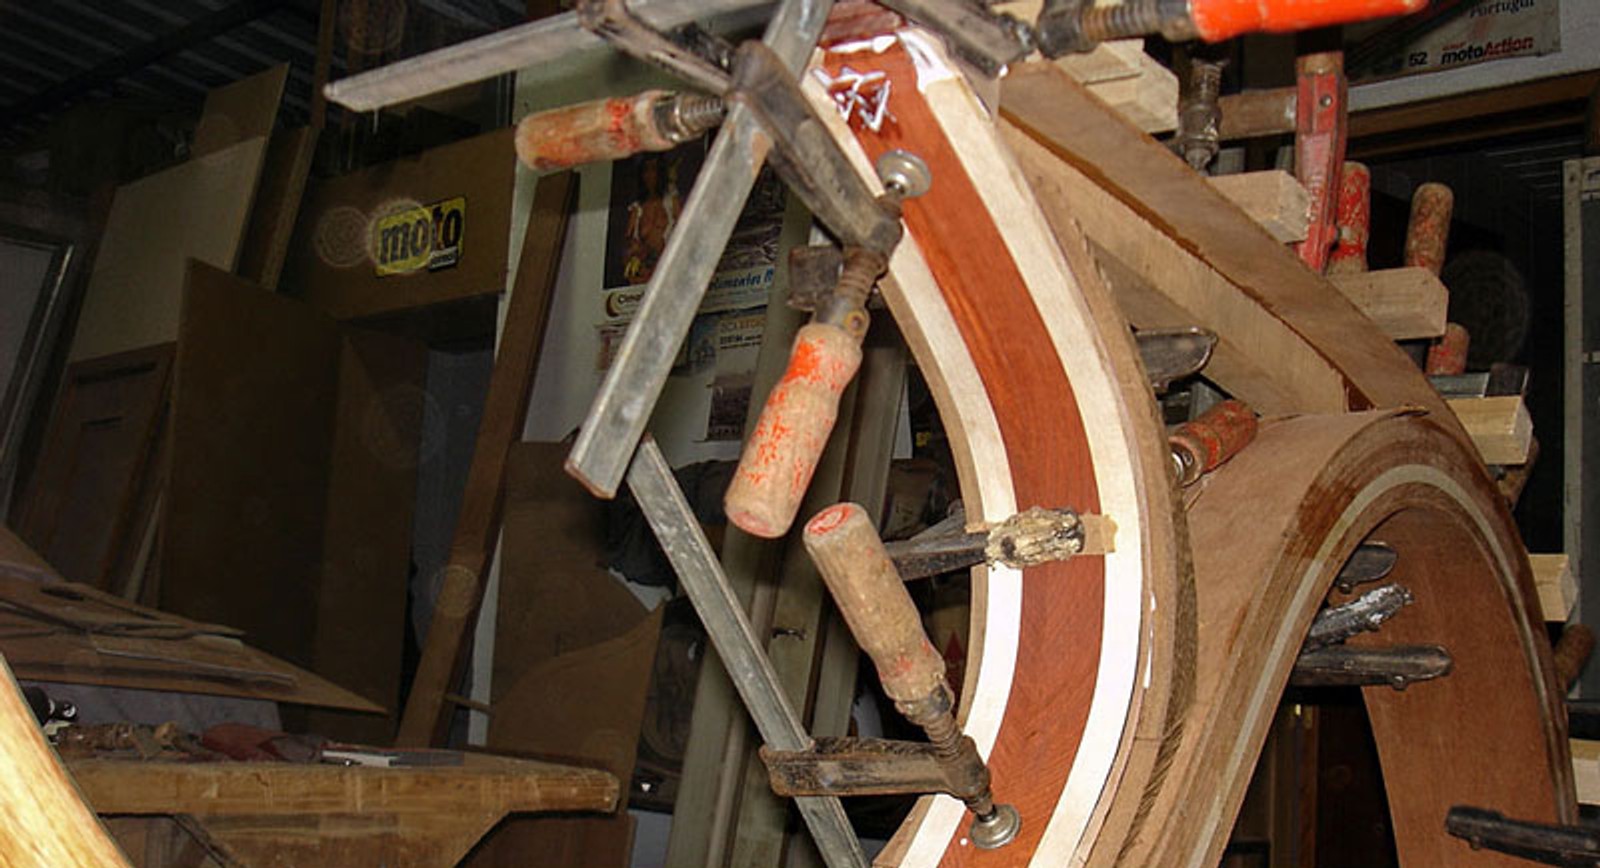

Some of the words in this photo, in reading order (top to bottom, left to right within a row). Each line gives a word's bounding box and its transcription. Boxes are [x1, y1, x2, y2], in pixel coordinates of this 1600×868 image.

[1408, 52, 1428, 66] 52
[1441, 37, 1534, 65] motoAction
[380, 206, 463, 265] moto
